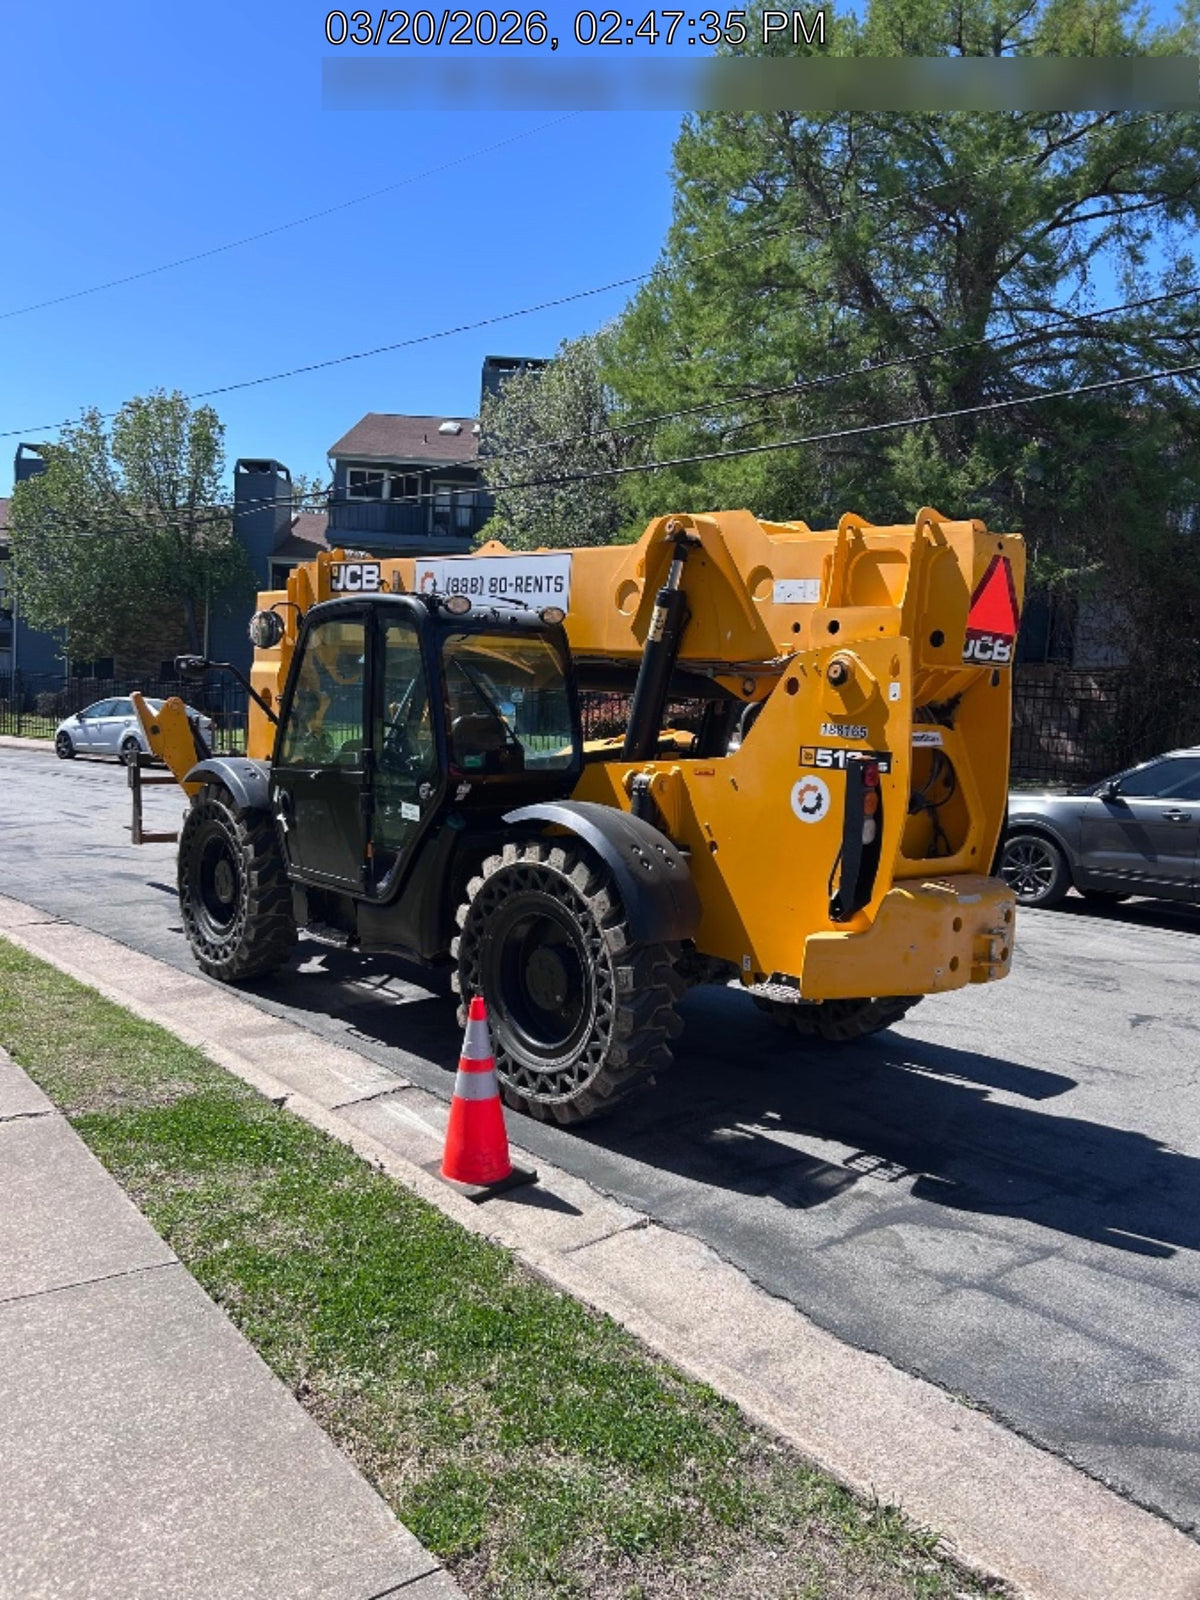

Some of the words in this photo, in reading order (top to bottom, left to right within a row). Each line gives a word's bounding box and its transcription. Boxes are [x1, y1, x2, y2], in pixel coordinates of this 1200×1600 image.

[331, 564, 379, 591] JCB
[488, 575, 565, 593] 80-RENTS
[962, 636, 1011, 661] JCB
